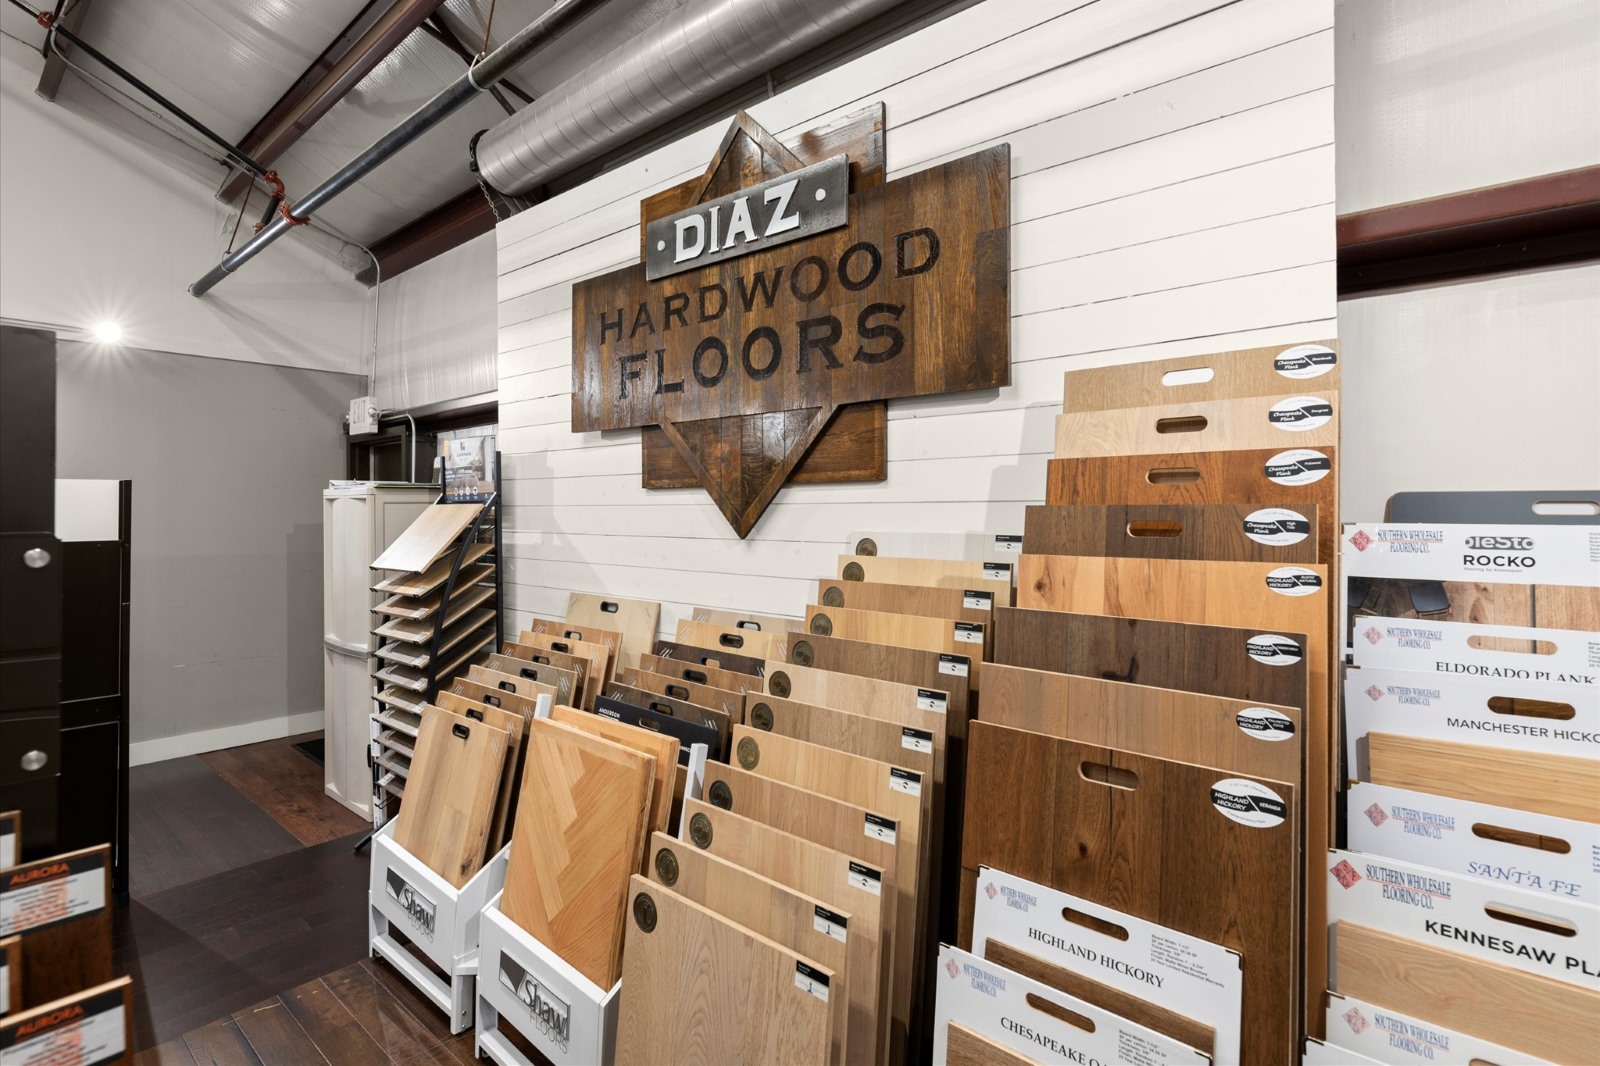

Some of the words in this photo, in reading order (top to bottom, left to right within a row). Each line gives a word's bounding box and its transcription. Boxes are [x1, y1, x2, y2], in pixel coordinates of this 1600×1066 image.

[674, 180, 800, 264] DIAZ
[600, 227, 941, 345] HARDWOOD
[619, 303, 906, 400] FLOORS
[1378, 530, 1408, 540] SOUTHERN
[1409, 531, 1443, 542] WHOLESALE
[1390, 542, 1420, 552] FLOORING
[1420, 543, 1430, 553] CO.
[1464, 555, 1536, 568] ROCKO
[1387, 627, 1413, 638] SOUTHERN
[1414, 630, 1442, 640] WHOLESALE
[1398, 638, 1422, 648] FLOORING
[1436, 661, 1530, 679] ELDORADO
[1387, 686, 1412, 696] SOUTHERN
[1412, 688, 1440, 699] WHOLESALE
[1398, 695, 1422, 706] FLOORING
[599, 708, 620, 718] ANDERSON
[1447, 718, 1548, 737] MANCHESTER
[1214, 792, 1249, 804] HIGHLAND
[1217, 800, 1246, 810] HICKORY
[1259, 802, 1282, 811] VERANDA
[1392, 806, 1421, 823] SOUTHERN
[1422, 811, 1455, 829] WHOLESALE
[1404, 822, 1430, 838] FLOORING
[1431, 827, 1442, 840] CO.
[10, 864, 70, 885] AURORA
[1366, 864, 1406, 886] SOUTHERN
[1406, 872, 1452, 898] WHOLESALE
[1468, 861, 1542, 888] SANTA
[1549, 880, 1581, 897] FE
[1382, 885, 1420, 907] FLOORING
[1420, 894, 1434, 910] CO.
[403, 888, 434, 932] Shaw
[407, 915, 434, 944] FLOORS
[1028, 927, 1097, 962] HIGHLAND
[1100, 954, 1164, 989] HICKORY
[1425, 920, 1556, 964] KENNESAW
[1566, 956, 1600, 978] PL
[16, 1005, 84, 1037] AURORA
[524, 979, 570, 1040] Shaw
[530, 1010, 568, 1054] FLOORS
[1000, 1017, 1086, 1066] CHESAPEAKE
[1374, 1014, 1409, 1035] SOUTHERN
[1410, 1024, 1449, 1050] WHOLESALE
[1389, 1034, 1420, 1056] FLOORING
[1420, 1044, 1434, 1060] CO.
